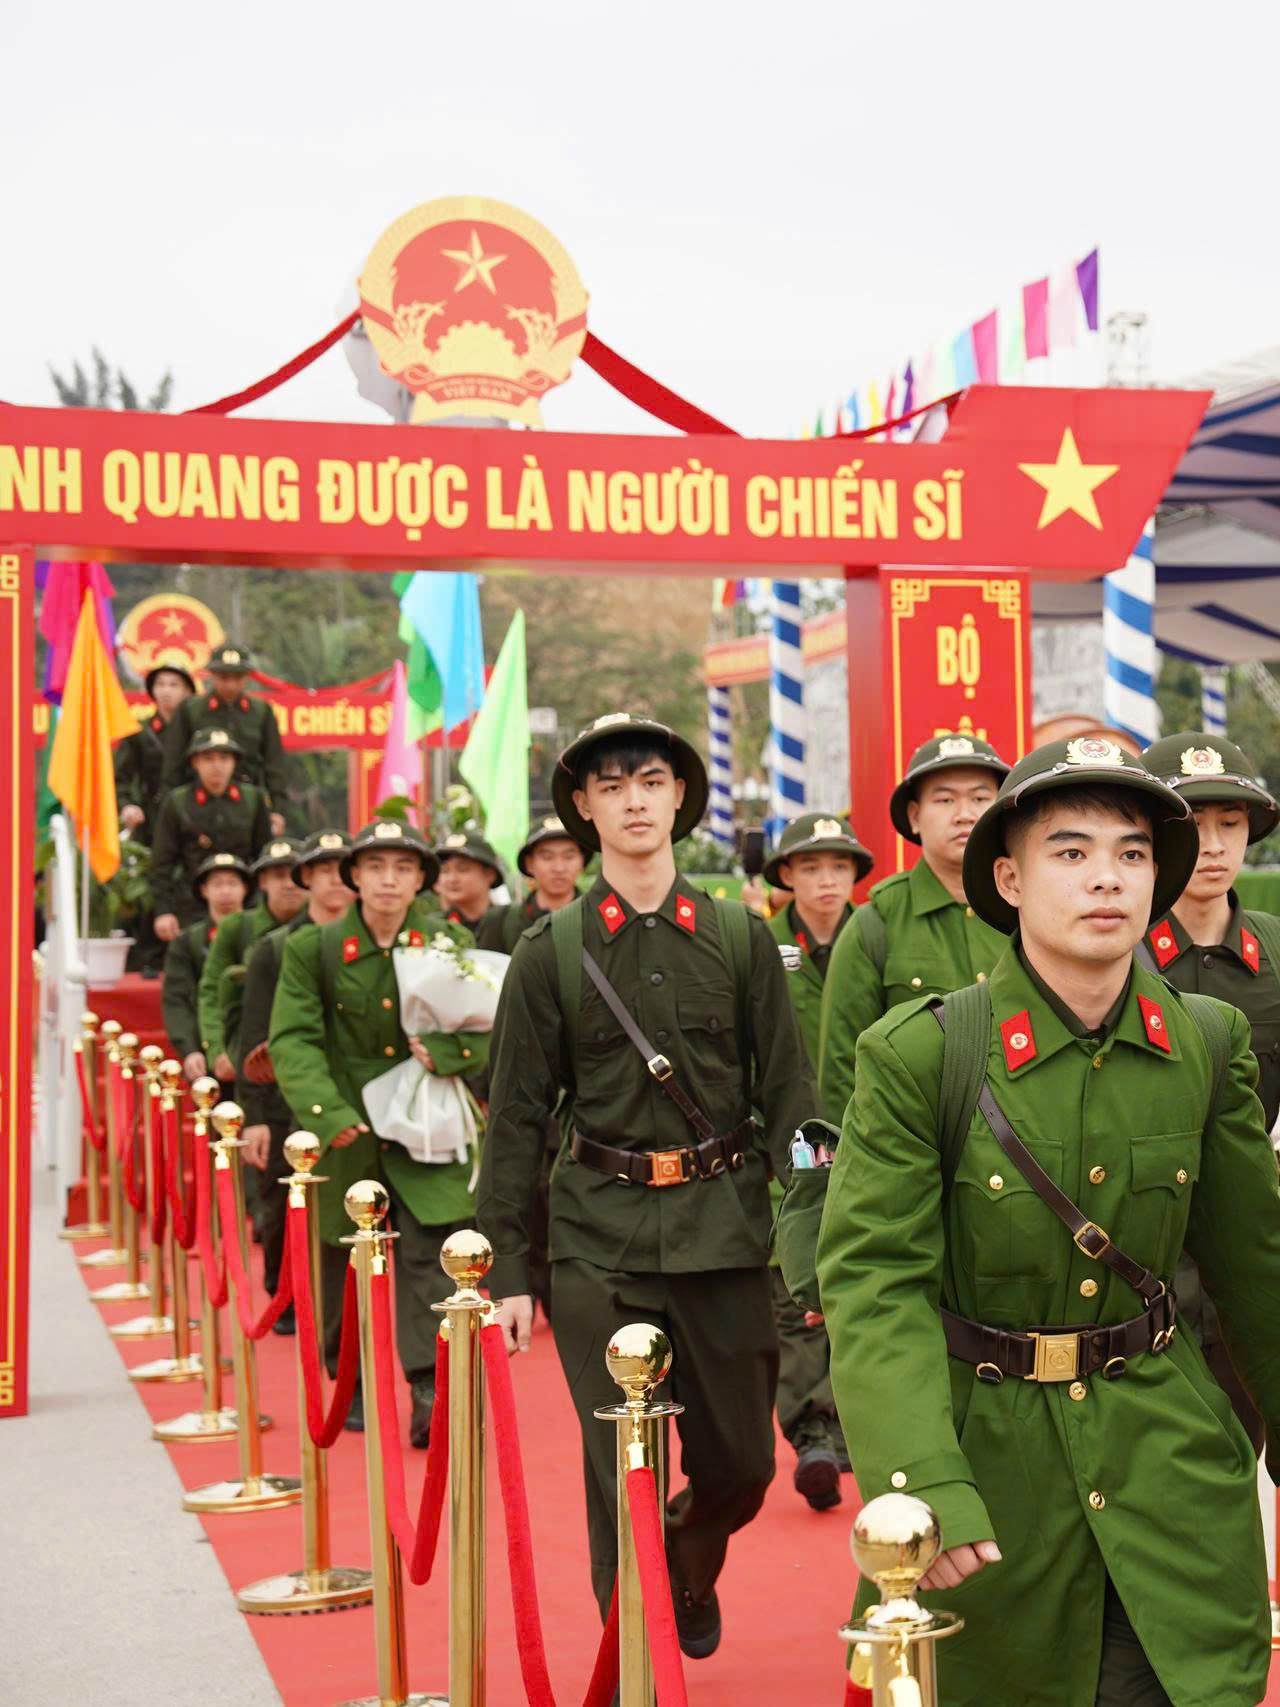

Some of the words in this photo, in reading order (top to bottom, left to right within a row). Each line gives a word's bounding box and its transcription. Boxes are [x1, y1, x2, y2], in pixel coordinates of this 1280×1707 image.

[102, 448, 300, 523] QUANG
[316, 456, 468, 541] ĐƯỢC
[486, 454, 553, 531] LÀ
[567, 458, 730, 536] NGƯỜI
[745, 459, 898, 539] CHIẾN
[912, 469, 965, 540] SĨ
[937, 613, 980, 699] BỘ
[292, 697, 366, 736] CHIẾN
